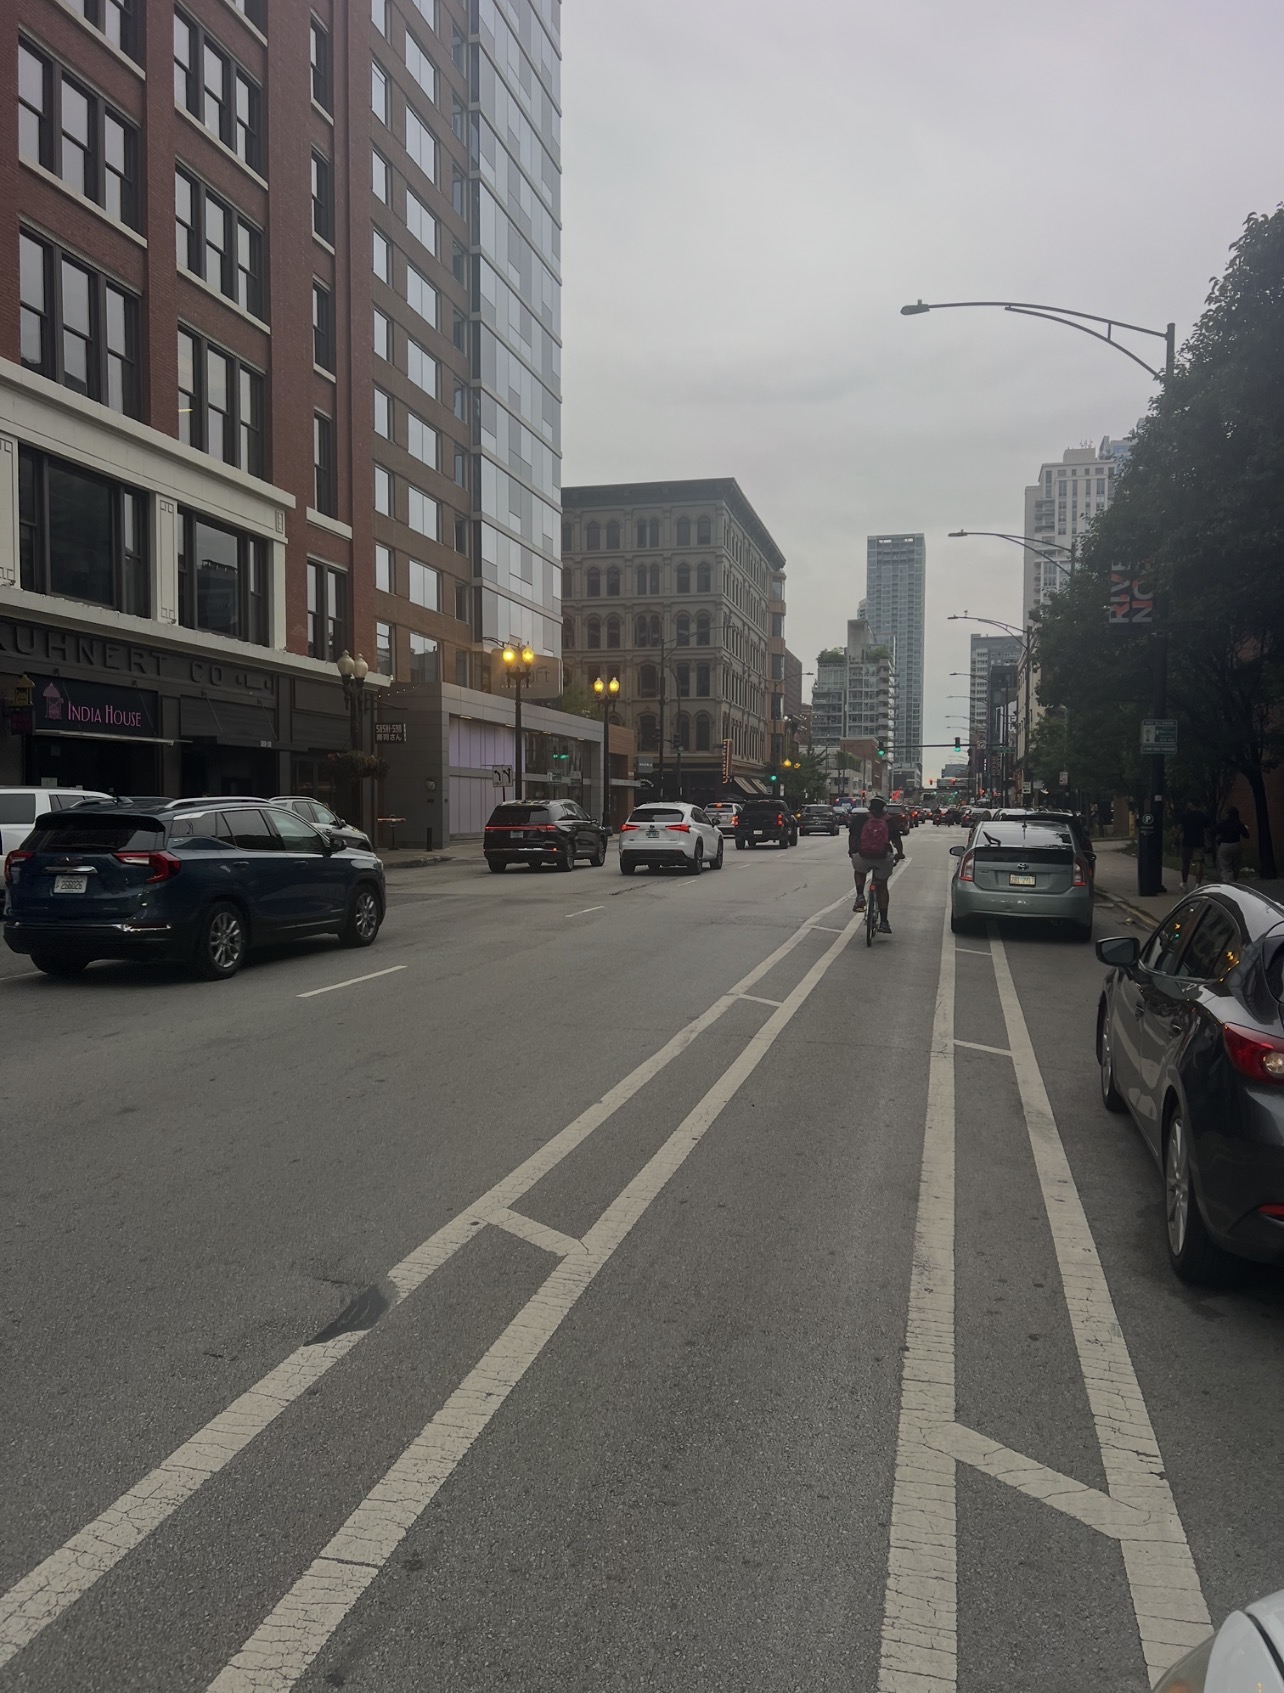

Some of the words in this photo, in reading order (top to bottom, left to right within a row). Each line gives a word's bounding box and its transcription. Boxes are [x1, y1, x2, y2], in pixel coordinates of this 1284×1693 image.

[1109, 560, 1130, 623] RIVE
[68, 701, 102, 723] INDIA
[105, 704, 142, 726] HOUSE
